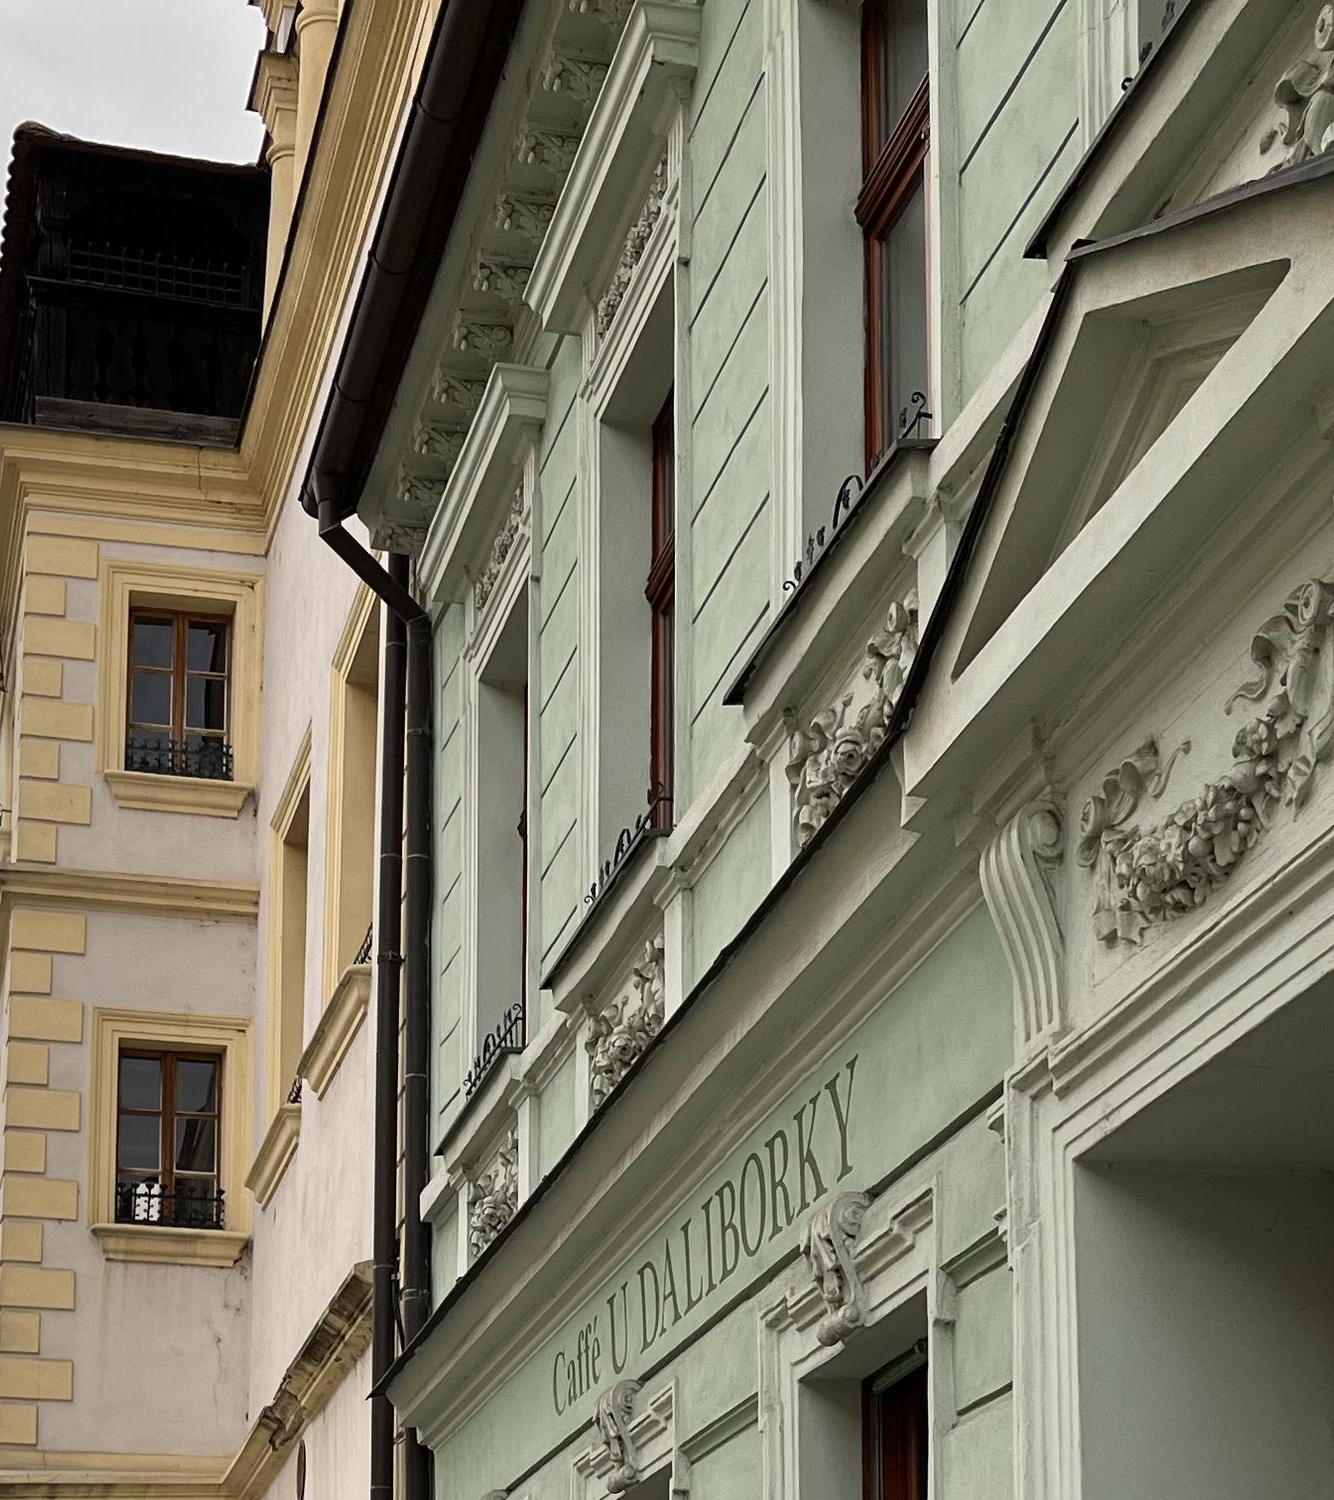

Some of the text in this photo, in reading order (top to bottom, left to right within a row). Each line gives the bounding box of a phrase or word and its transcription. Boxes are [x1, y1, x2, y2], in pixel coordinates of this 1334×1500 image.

[553, 1053, 859, 1417] Caffé U DALIBORKY
